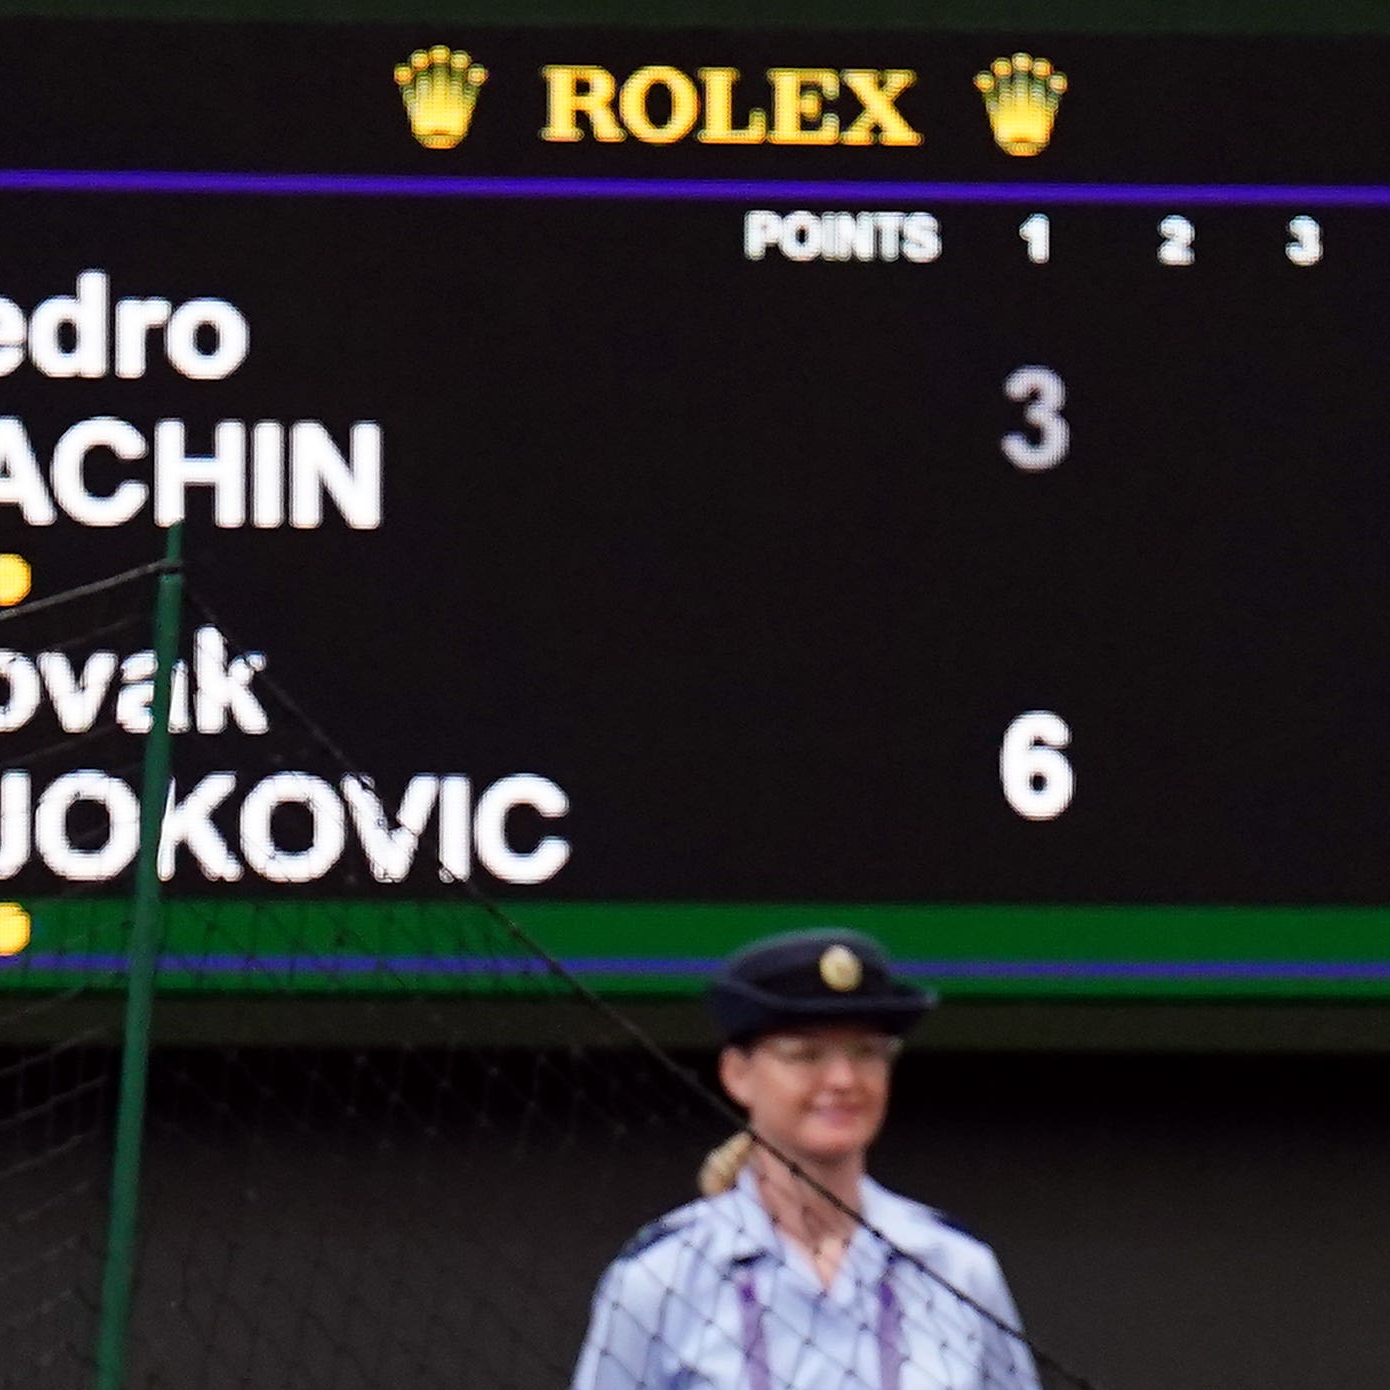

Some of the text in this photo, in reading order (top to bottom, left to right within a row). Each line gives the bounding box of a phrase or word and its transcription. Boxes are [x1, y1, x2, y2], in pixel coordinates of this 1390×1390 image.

[540, 64, 923, 148] ROLEX
[743, 210, 943, 264] POINTS
[1018, 214, 1051, 264] 1
[1157, 215, 1196, 267] 2
[1284, 215, 1324, 267] 3
[1001, 366, 1071, 471] 3
[998, 709, 1075, 822] 6
